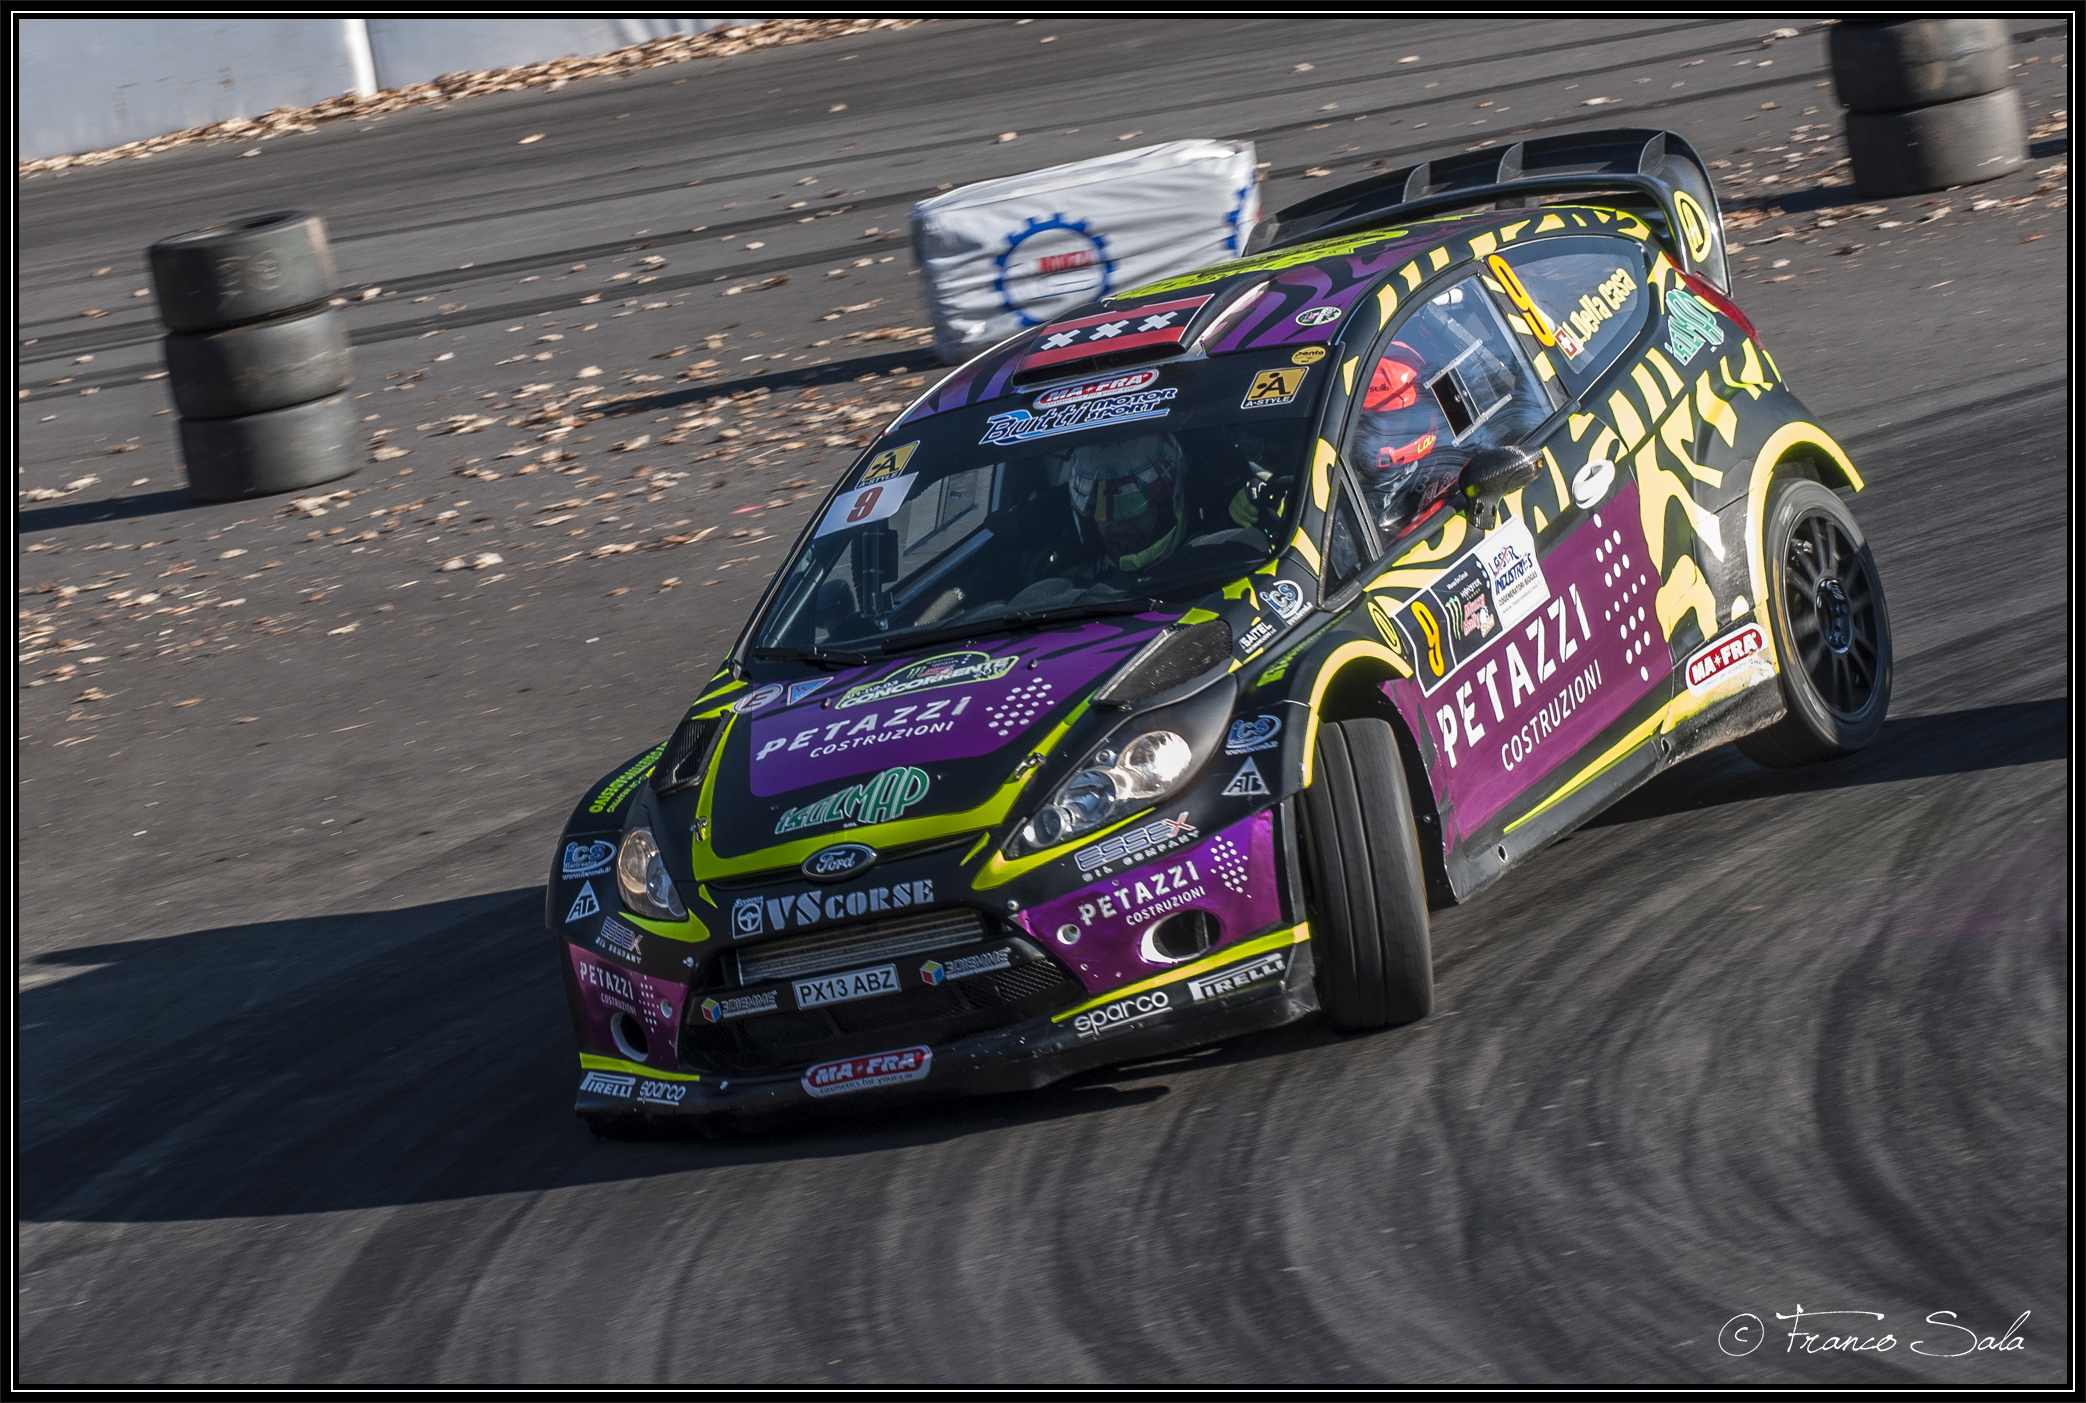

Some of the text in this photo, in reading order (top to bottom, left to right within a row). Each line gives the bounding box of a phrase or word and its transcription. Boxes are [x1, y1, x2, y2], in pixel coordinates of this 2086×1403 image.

[1488, 254, 1556, 347] 9
[1598, 267, 1637, 311] Casa
[1085, 400, 1160, 422] SPORT
[1089, 388, 1178, 411] MOTOR
[979, 402, 1091, 444] Butti
[847, 486, 884, 523] 9
[1411, 601, 1445, 677] 9
[842, 656, 1010, 708] CONCORRENTE
[1436, 583, 1591, 769] PETAZZI
[756, 696, 973, 761] PETAZZI
[1500, 659, 1603, 772] COSTRUZIONI
[809, 720, 955, 758] COSTRUZIONI
[1227, 771, 1265, 793] ATB
[816, 850, 857, 874] Ford
[1074, 811, 1197, 873] ESSEX
[1082, 829, 1200, 882] OIL COMPANY
[1079, 860, 1201, 927] PETAZZI
[1126, 885, 1206, 926] COSTRUZIONI
[601, 916, 644, 956] ESSEX
[608, 943, 642, 965] COMPANY
[580, 961, 634, 1000] PETAZZI
[800, 970, 895, 1004] PX13 ABZ
[1187, 953, 1286, 1001] PIRELLI
[601, 992, 637, 1016] COSTRUZIONI
[1074, 991, 1169, 1035] sparco
[580, 1071, 636, 1098] PIRELLI
[640, 1080, 686, 1104] sparco
[862, 1078, 874, 1087] for
[877, 1075, 898, 1085] your
